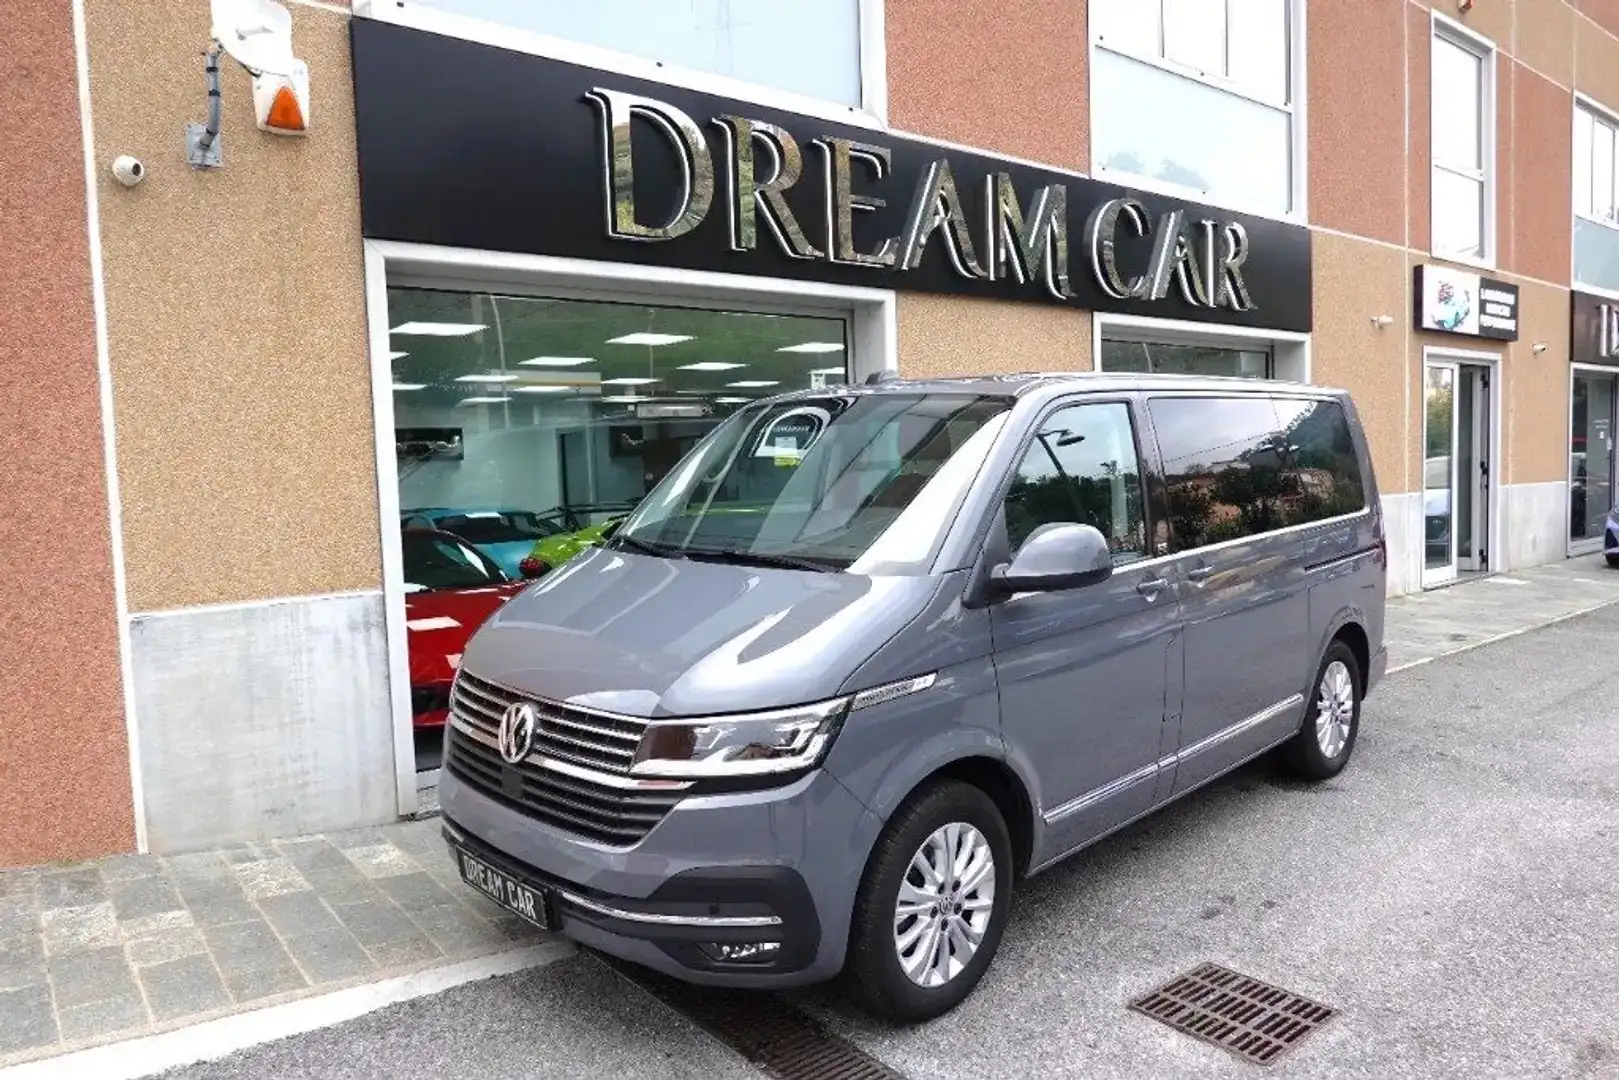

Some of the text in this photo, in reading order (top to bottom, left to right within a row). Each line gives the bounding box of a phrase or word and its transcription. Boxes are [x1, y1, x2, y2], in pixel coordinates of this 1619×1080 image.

[584, 86, 1258, 311] DREAM CAR
[463, 855, 537, 920] DREAM CAR
